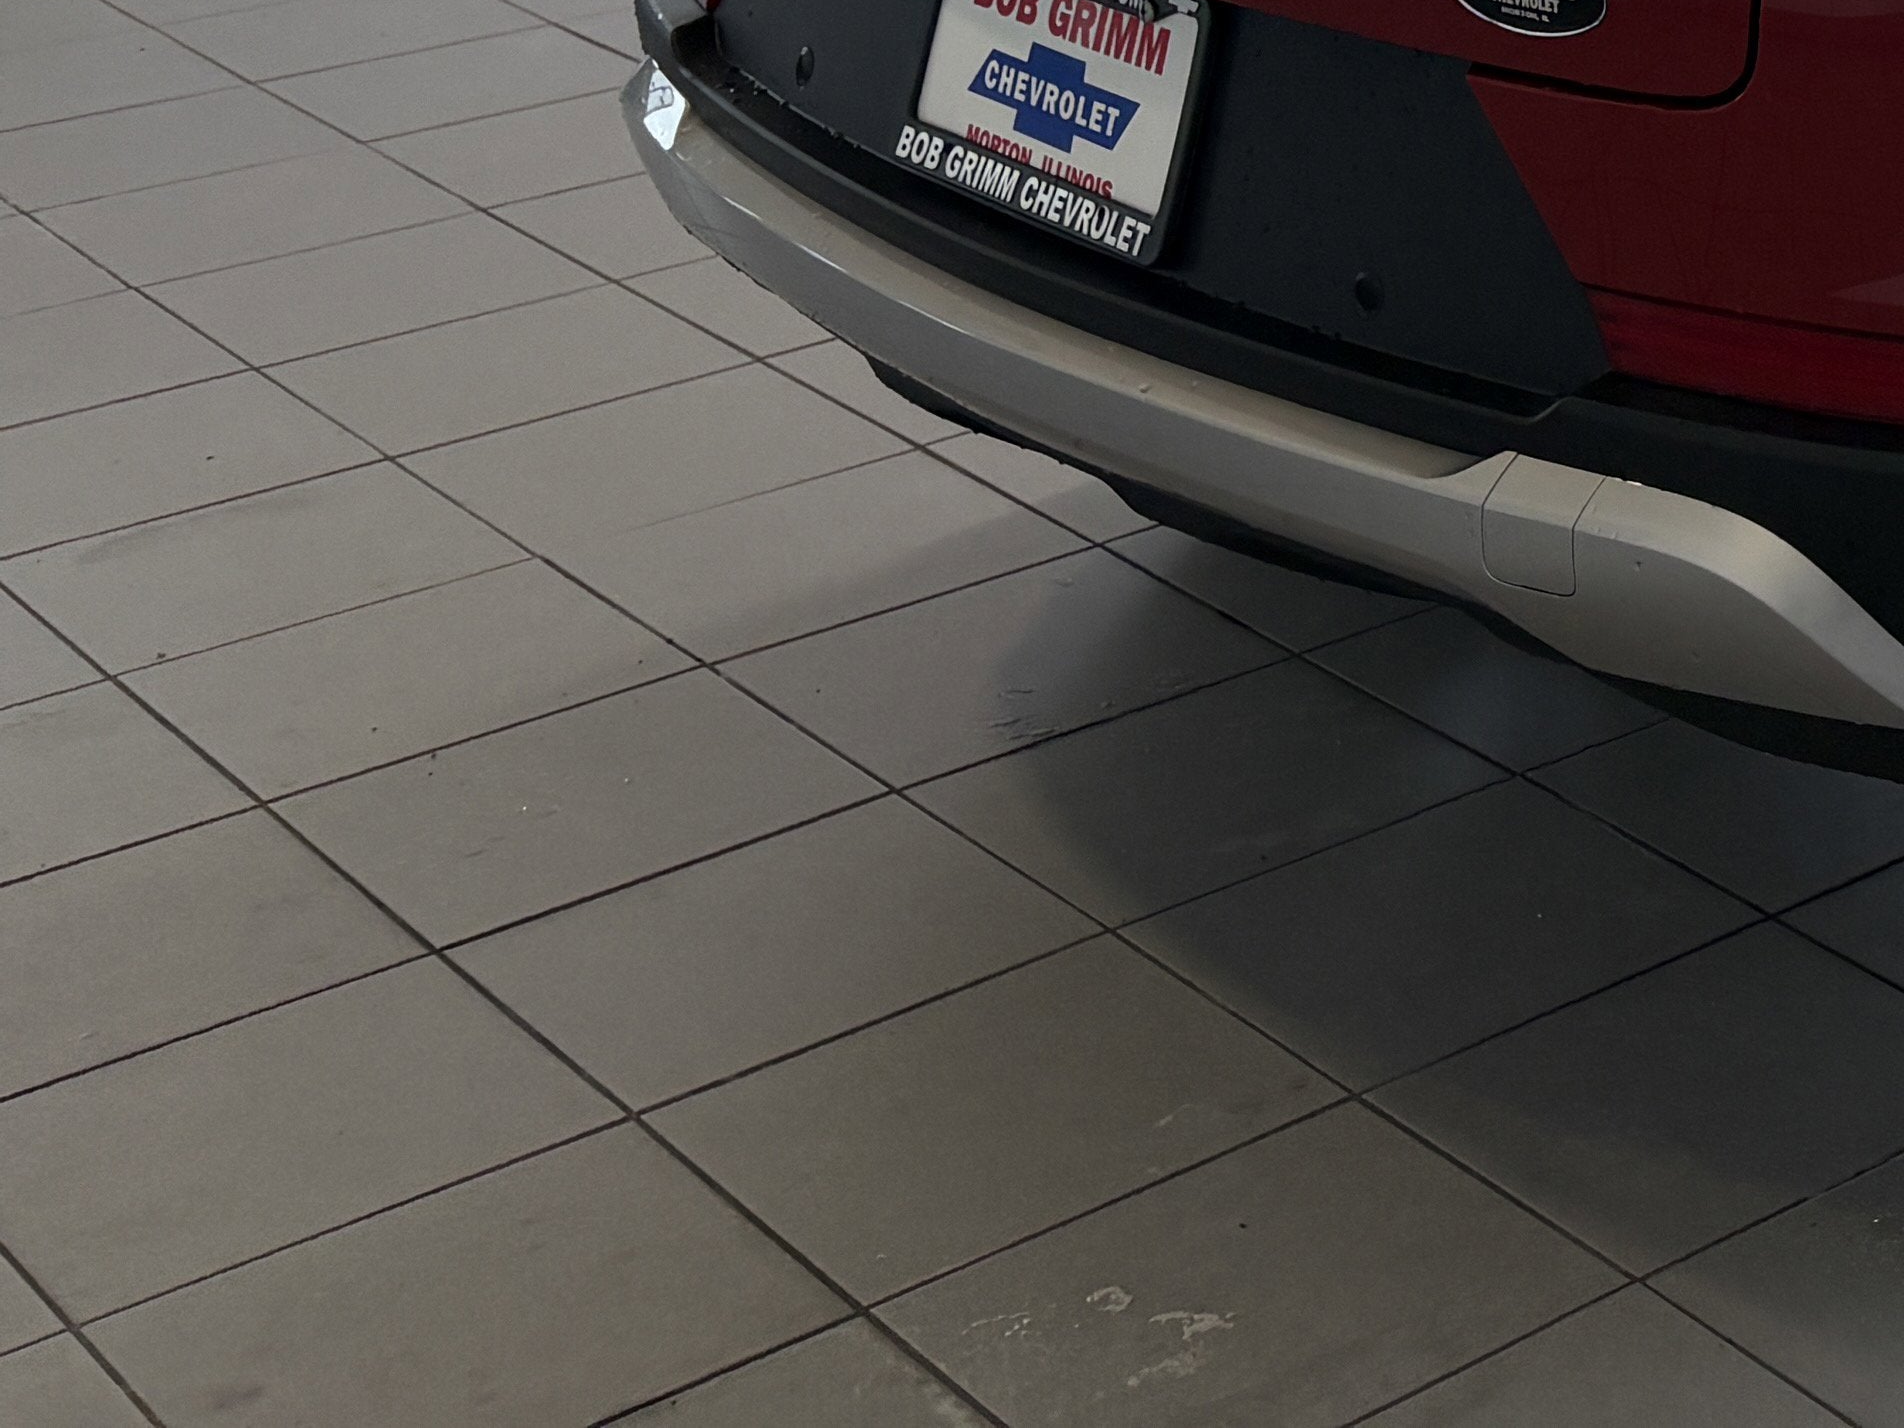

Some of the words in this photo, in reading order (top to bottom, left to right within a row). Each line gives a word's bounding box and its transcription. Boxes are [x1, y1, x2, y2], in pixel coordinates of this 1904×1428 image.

[984, 59, 1121, 137] CHEVROLET
[895, 124, 945, 170] BOB
[944, 145, 1021, 204] GRIMM
[1019, 176, 1151, 257] CHEVROLET
[966, 123, 1033, 166] MORTON
[1042, 154, 1114, 199] ILLINOIS
